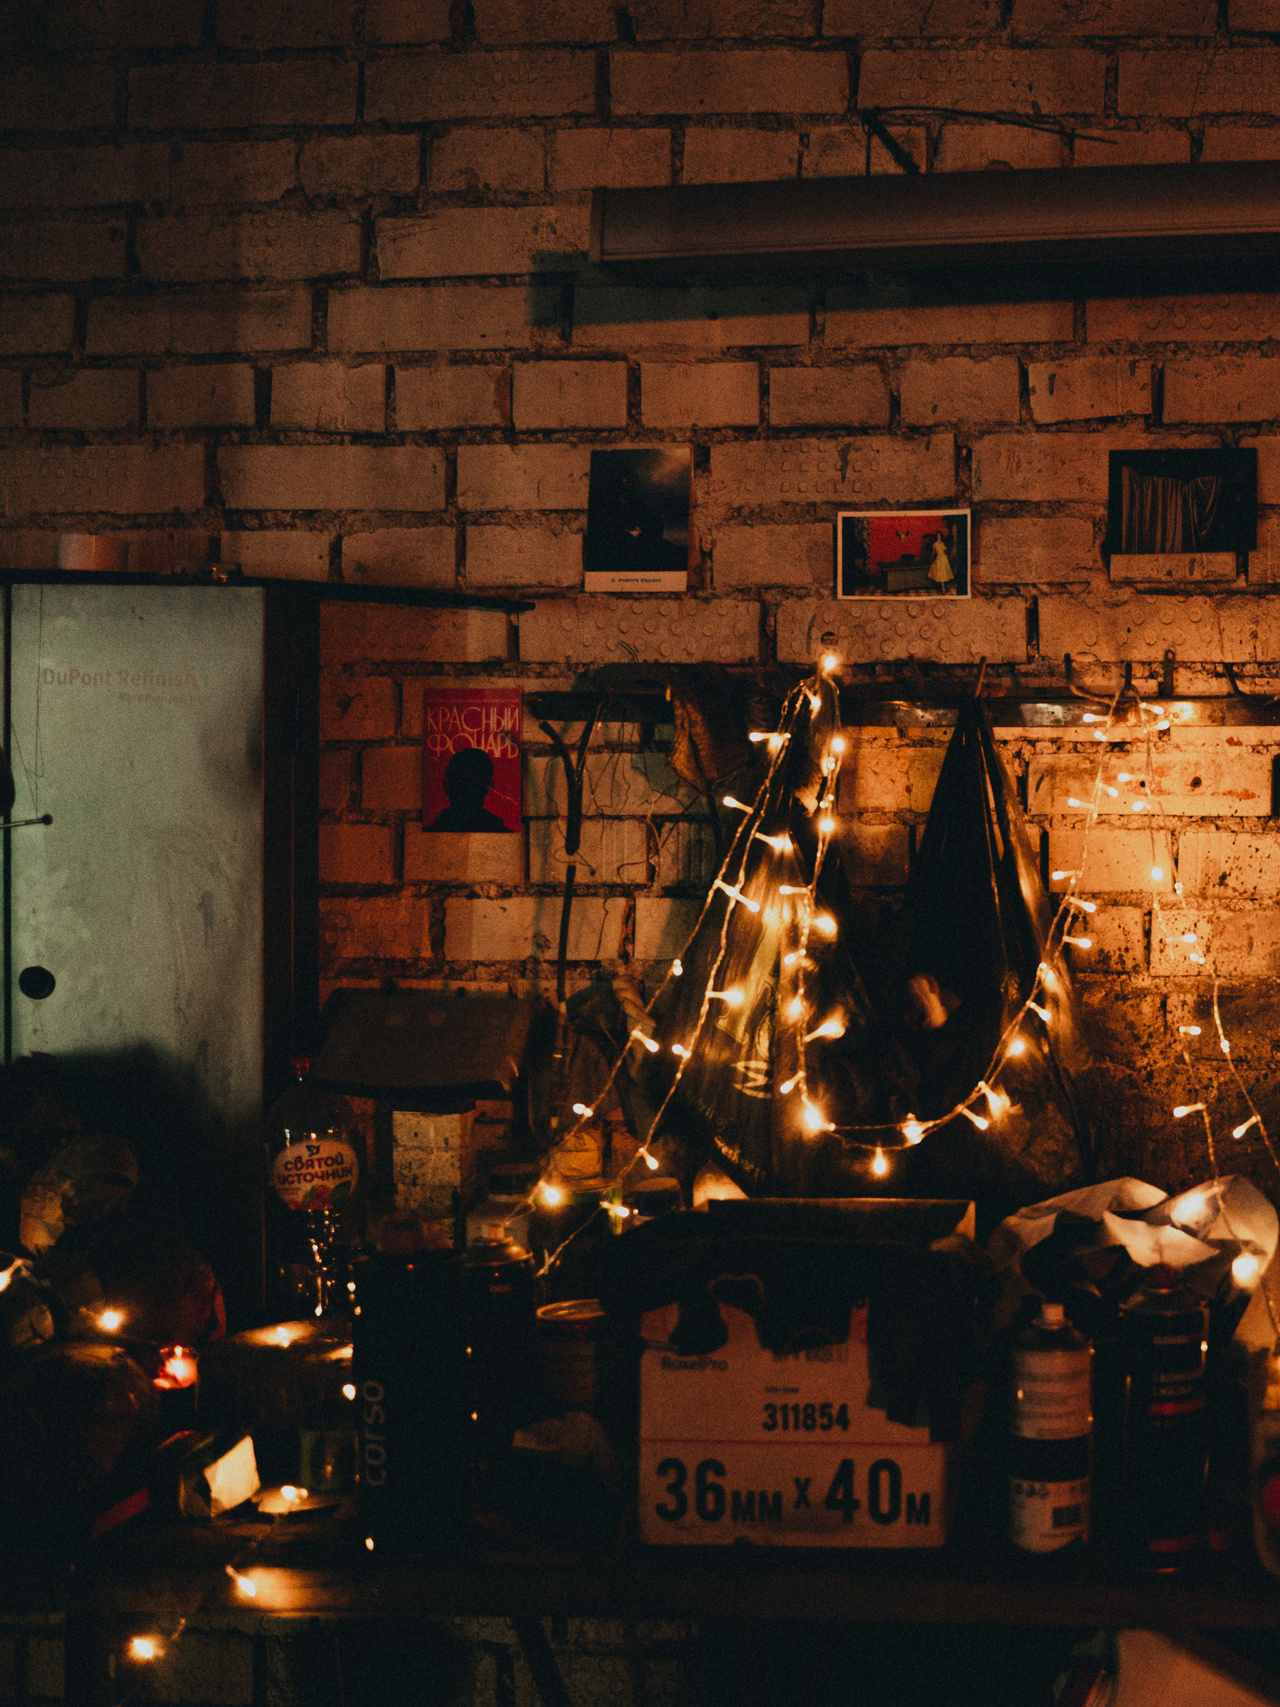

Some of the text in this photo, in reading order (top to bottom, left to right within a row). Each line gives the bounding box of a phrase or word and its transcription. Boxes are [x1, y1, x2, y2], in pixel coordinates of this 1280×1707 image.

[42, 668, 196, 687] DuPont Refinish
[427, 705, 519, 733] КРАСНЫЙ
[427, 732, 519, 758] ФОНАРЬ
[763, 1403, 850, 1431] 311854
[363, 1381, 387, 1487] corso
